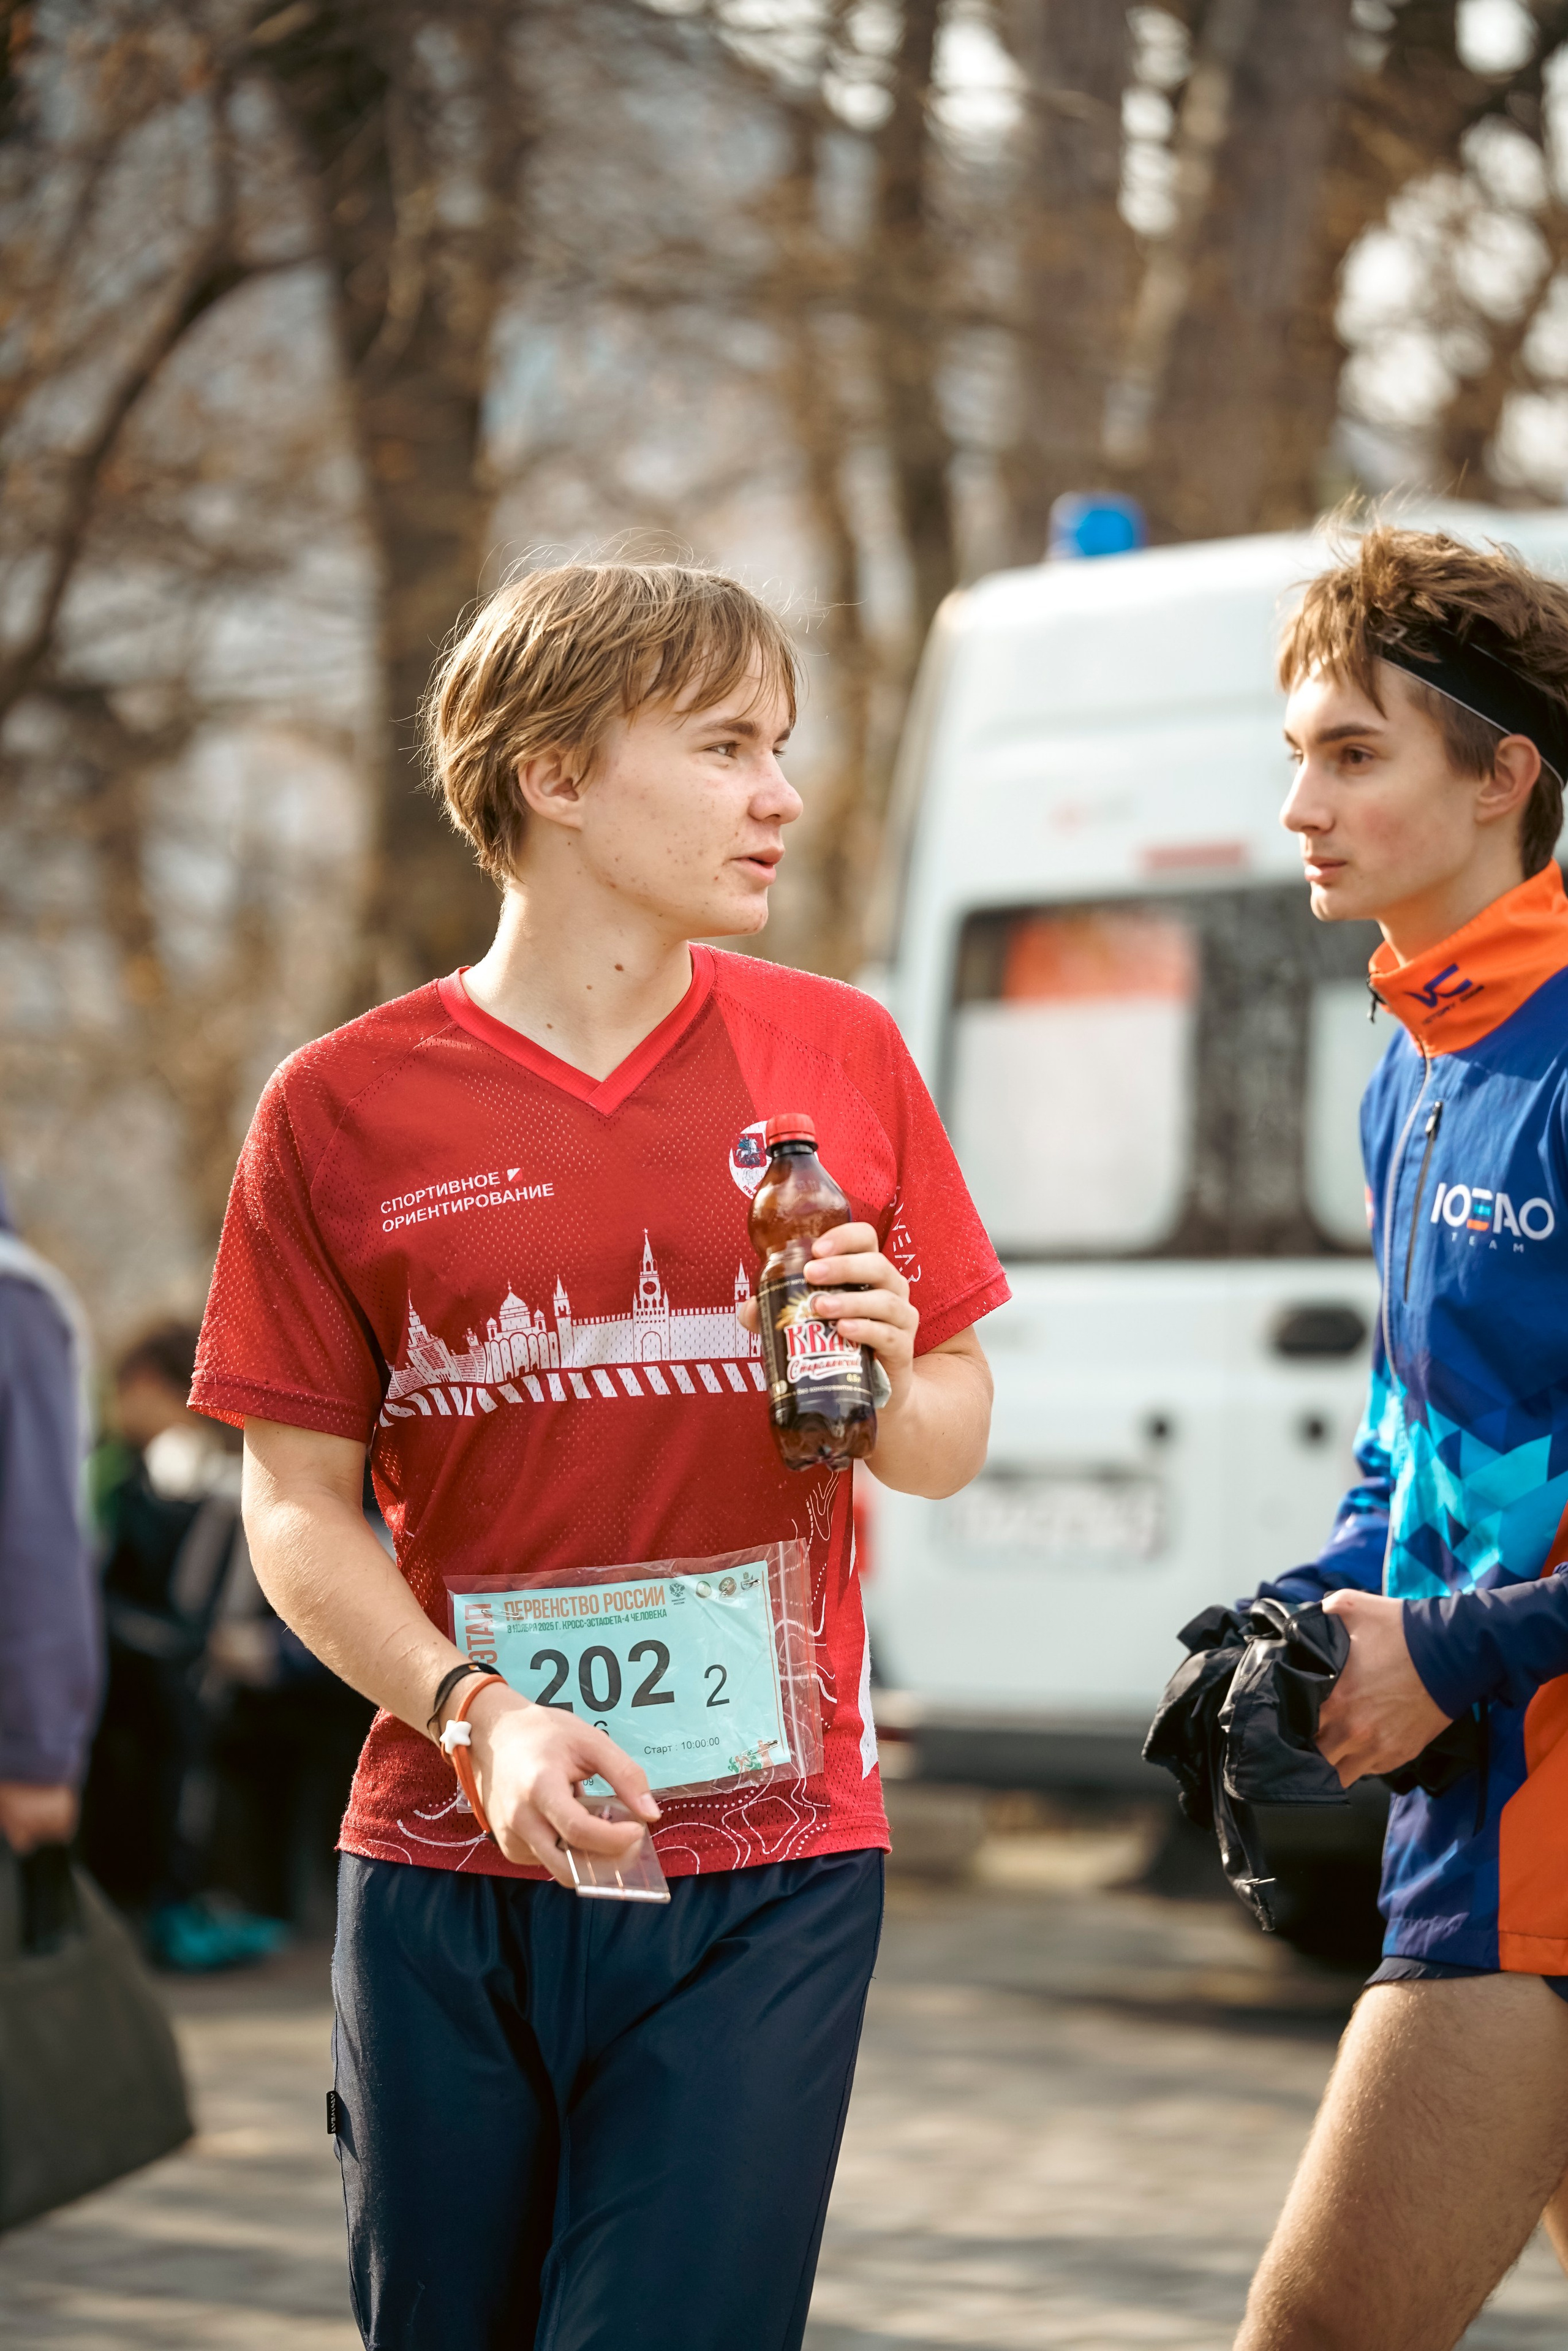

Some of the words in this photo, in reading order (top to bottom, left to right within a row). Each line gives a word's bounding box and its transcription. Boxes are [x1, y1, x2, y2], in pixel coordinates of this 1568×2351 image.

[380, 1171, 500, 1214] СПОРТИВНОЕ
[382, 1183, 555, 1232] ОРИЕНТИРОВАНИЕ
[1451, 1231, 1525, 1253] TEAM
[504, 1594, 600, 1621] ПЕРВЕНСТВО
[603, 1585, 666, 1613] РОССИИ
[507, 1625, 512, 1634] 8
[513, 1623, 538, 1633] НОЯБРЯ
[538, 1621, 554, 1631] 2025
[631, 1608, 668, 1622] ЧЕЛОВЕКА
[465, 1603, 498, 1665] ЭТАП
[530, 1640, 675, 1712] 202
[704, 1664, 730, 1707] 2
[644, 1745, 673, 1755] Старт
[681, 1737, 720, 1750] 10:00:00
